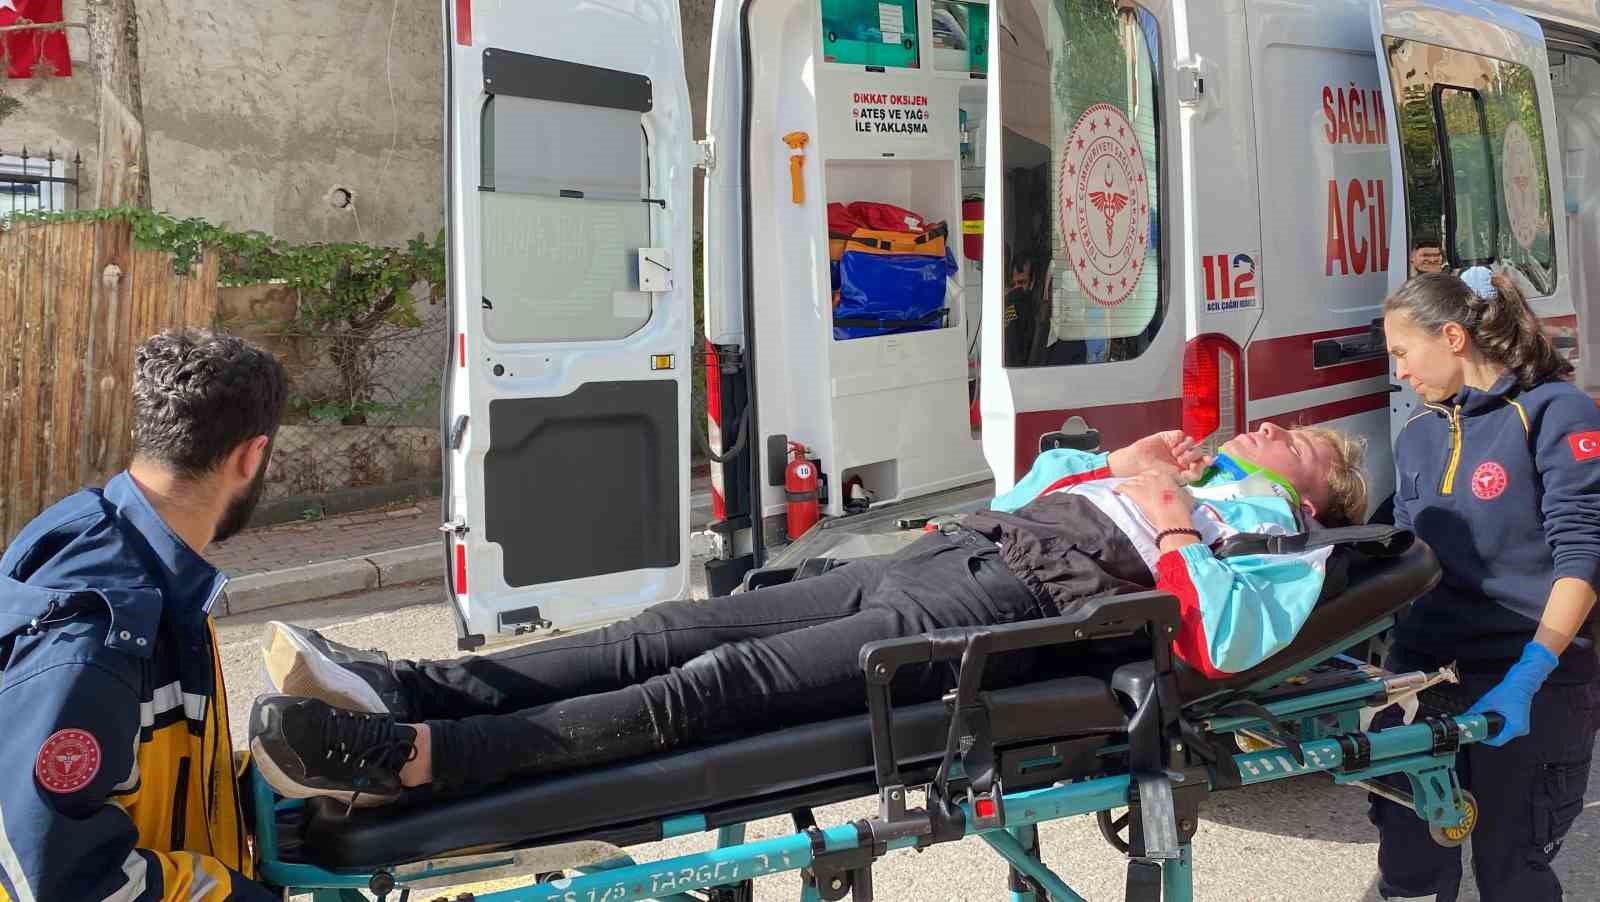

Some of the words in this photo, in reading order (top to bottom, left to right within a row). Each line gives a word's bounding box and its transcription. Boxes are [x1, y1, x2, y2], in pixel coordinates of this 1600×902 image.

[860, 108, 886, 120] ATEŞ
[888, 109, 901, 119] VE
[904, 108, 923, 120] YAĞ
[855, 119, 871, 132] İLE
[874, 122, 928, 135] YAKLAŞMA
[1202, 253, 1256, 300] 112
